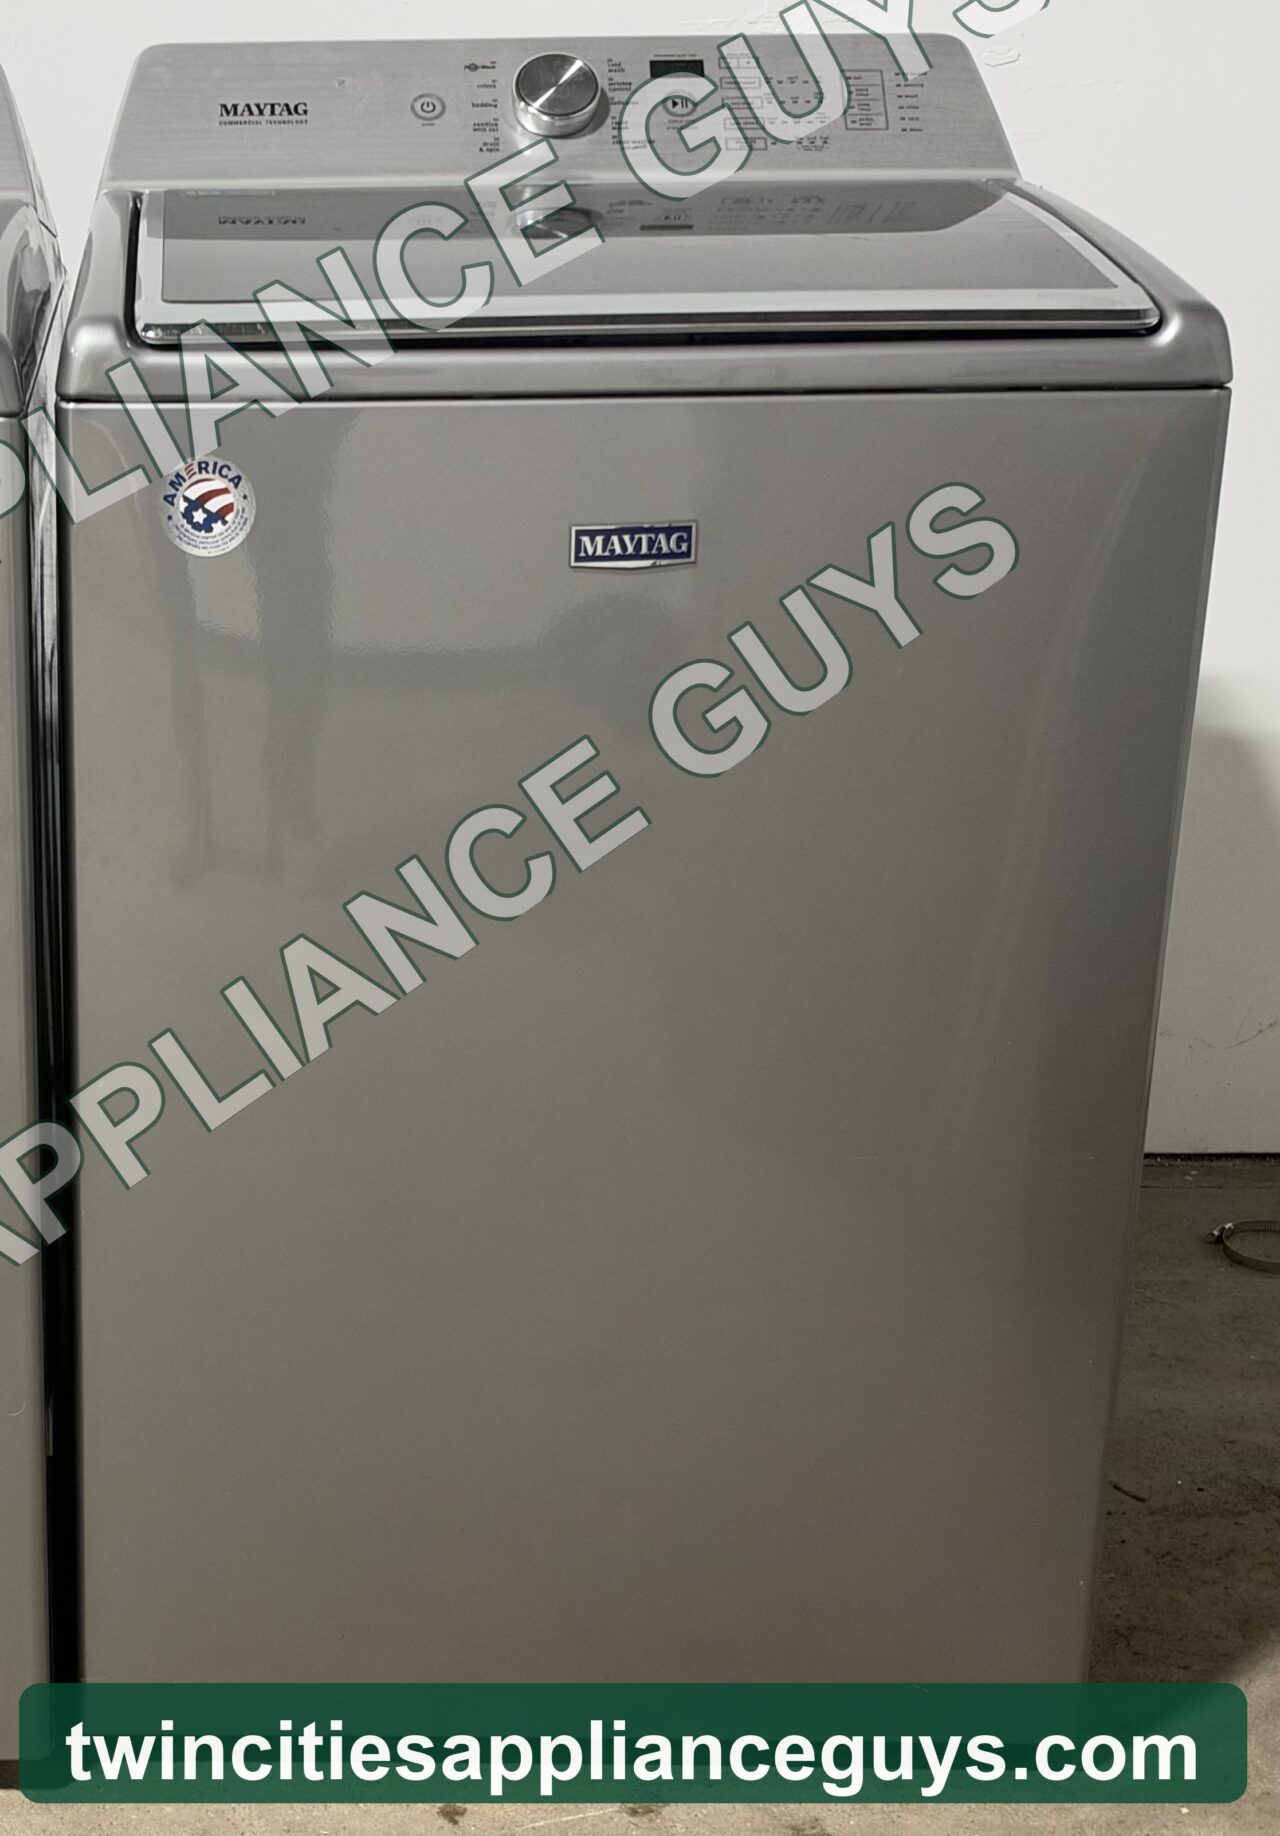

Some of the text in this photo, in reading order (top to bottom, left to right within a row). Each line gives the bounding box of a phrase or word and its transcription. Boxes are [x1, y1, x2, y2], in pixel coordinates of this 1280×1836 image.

[219, 102, 308, 117] MAYTAG
[163, 460, 242, 507] AMERICA
[579, 532, 688, 557] MAYTAG
